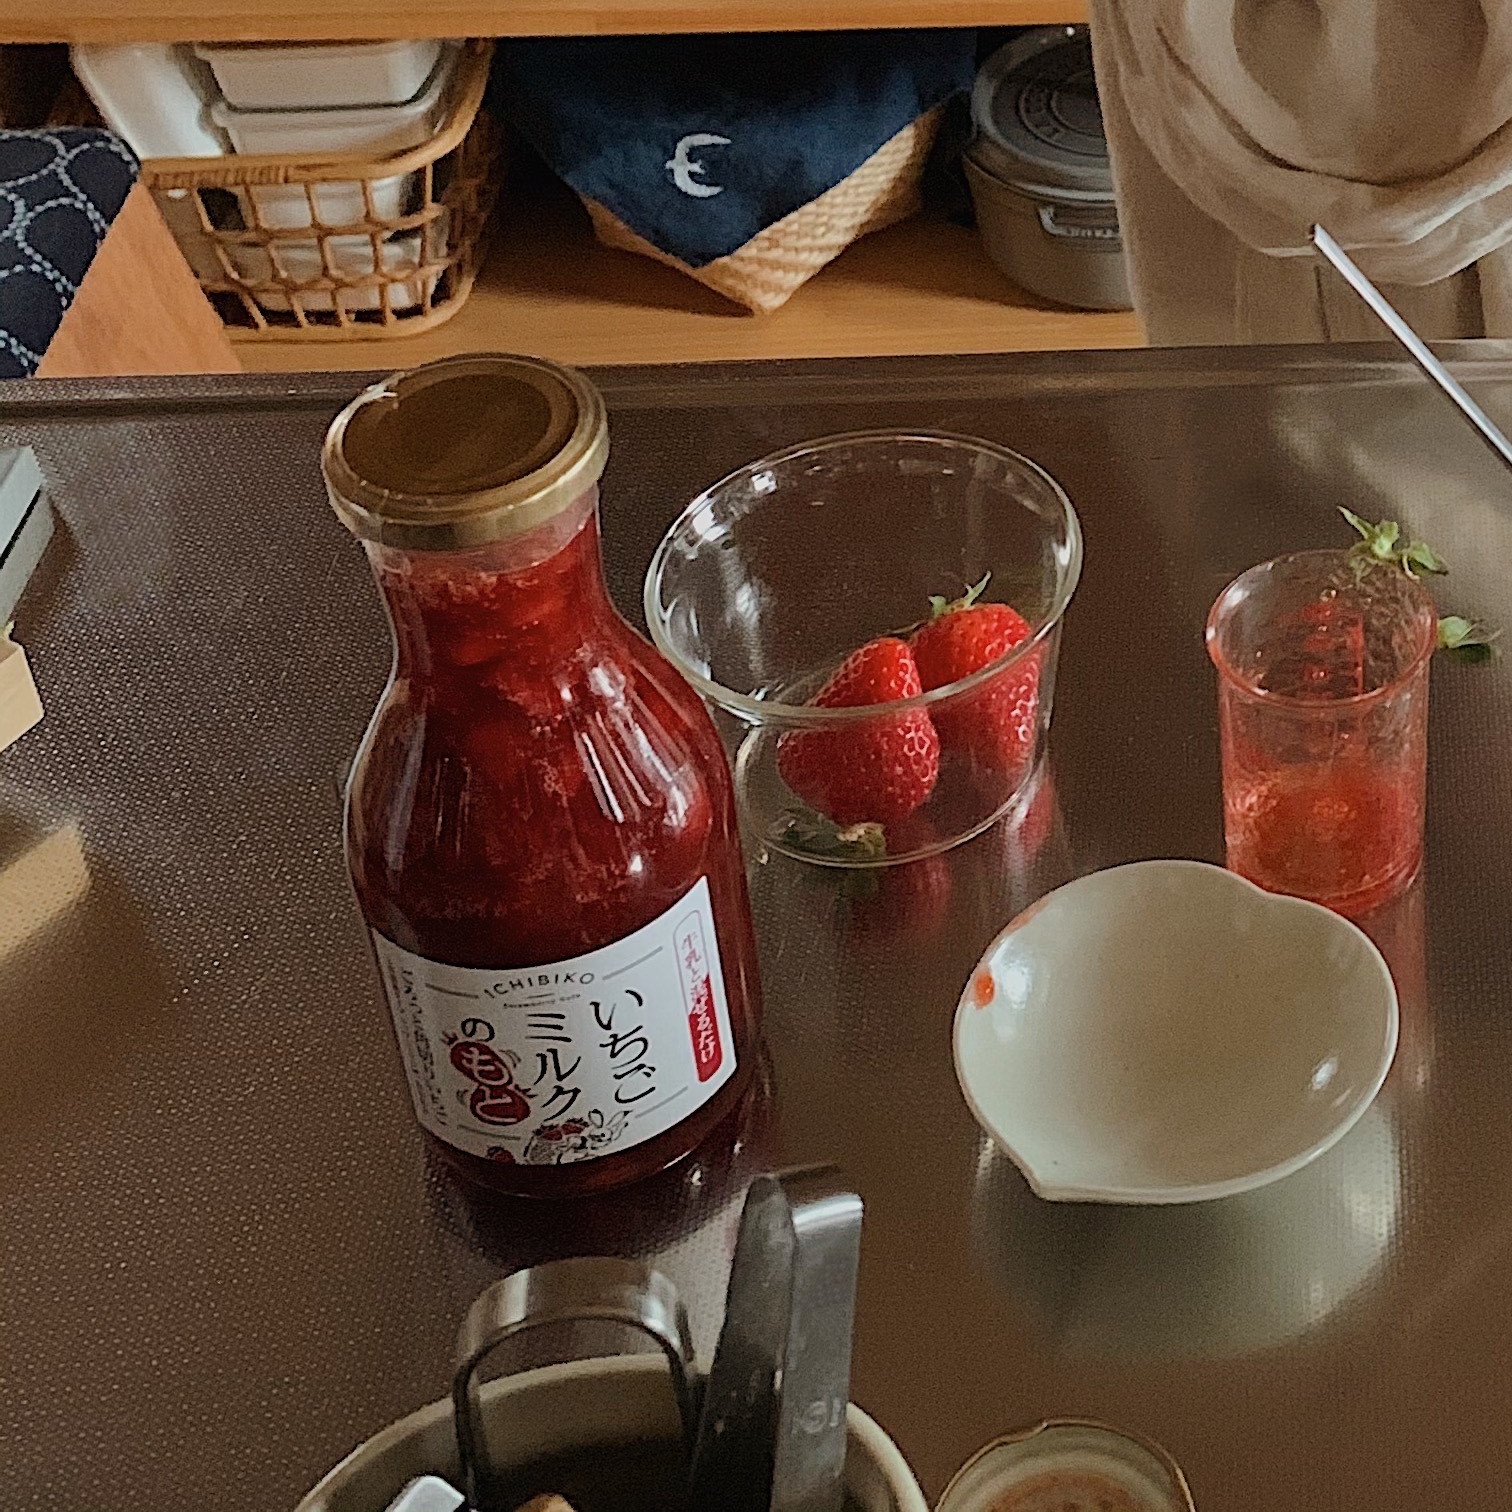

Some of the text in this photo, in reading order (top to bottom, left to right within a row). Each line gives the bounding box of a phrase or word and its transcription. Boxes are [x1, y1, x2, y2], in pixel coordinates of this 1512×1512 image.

[484, 972, 595, 999] ICHIBIKO
[525, 1012, 582, 1121] ミルク
[590, 988, 656, 1104] いちご
